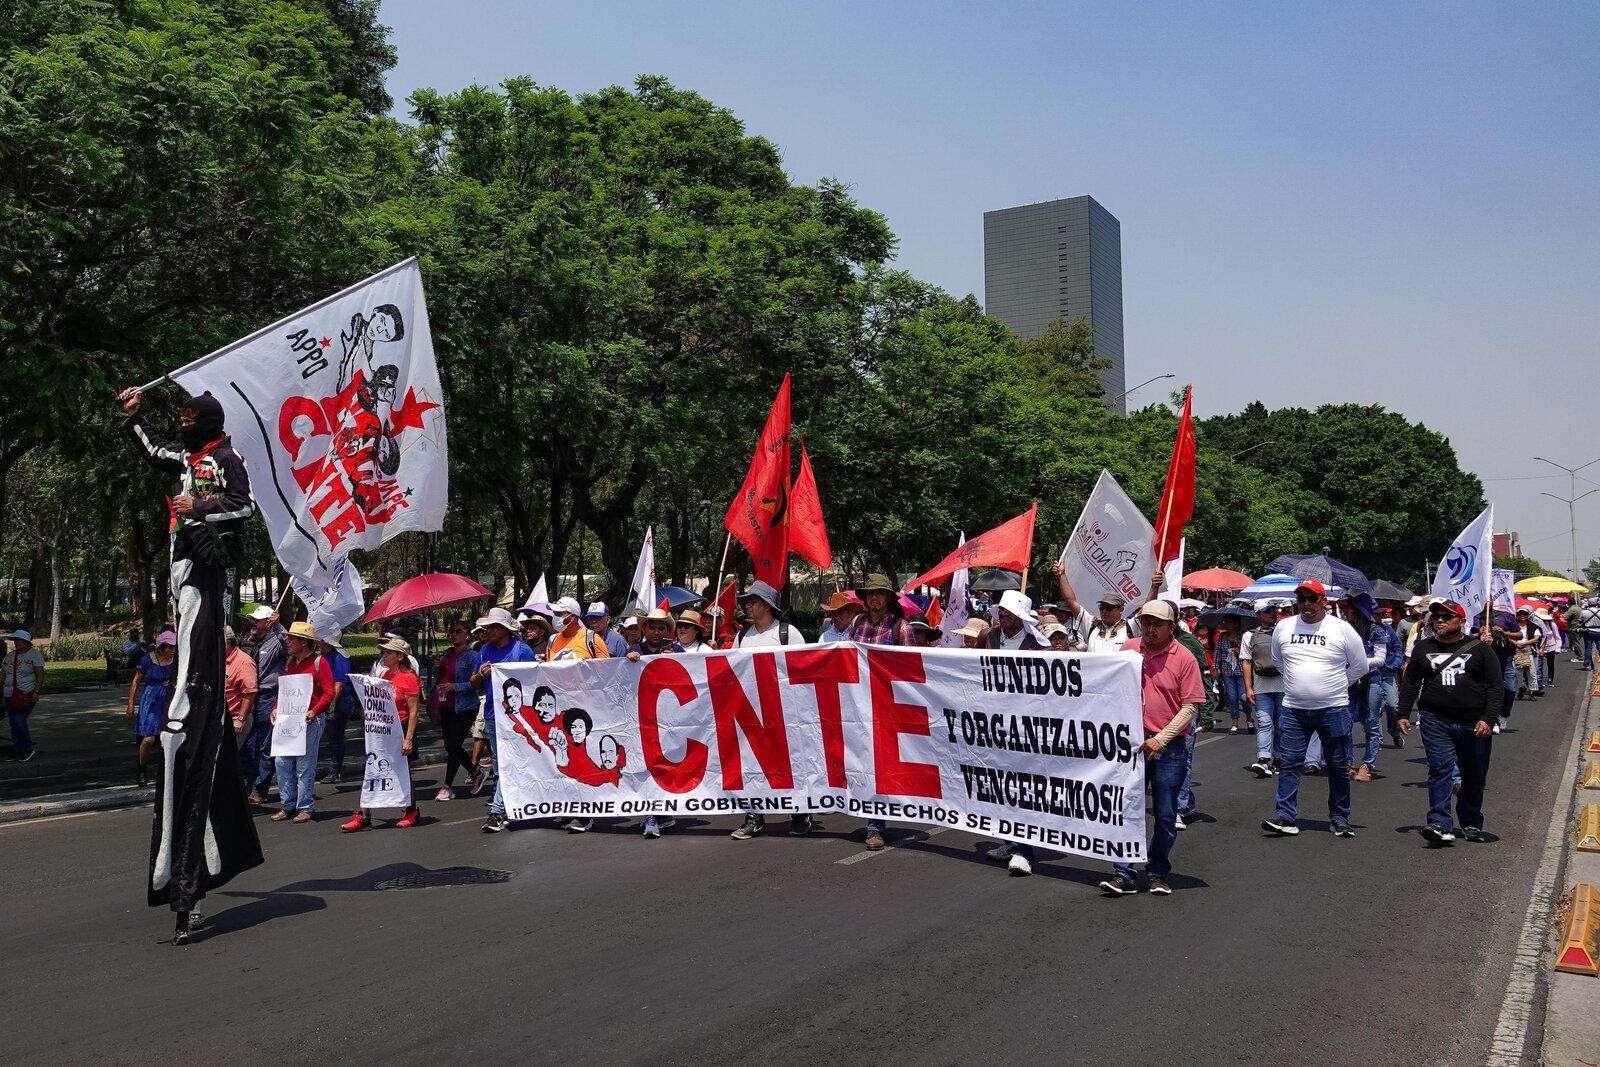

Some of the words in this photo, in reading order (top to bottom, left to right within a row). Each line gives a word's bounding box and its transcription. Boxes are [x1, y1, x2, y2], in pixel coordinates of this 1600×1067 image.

[286, 328, 329, 379] APPO
[1290, 633, 1326, 647] LEVI'S
[980, 656, 1083, 697] ¡¡UNIDOS
[637, 648, 943, 799] CNTE
[943, 708, 957, 743] Y
[961, 711, 1137, 771] ORGANIZADOS,
[960, 764, 1124, 826] VENCEREMOS!!
[621, 799, 678, 814] QUIEN
[685, 797, 799, 812] GOBIERNE,
[807, 795, 845, 809] LOS
[849, 798, 959, 824] DERECHOS
[966, 813, 992, 832] SE
[999, 820, 1141, 858] DEFIENDEN!!
